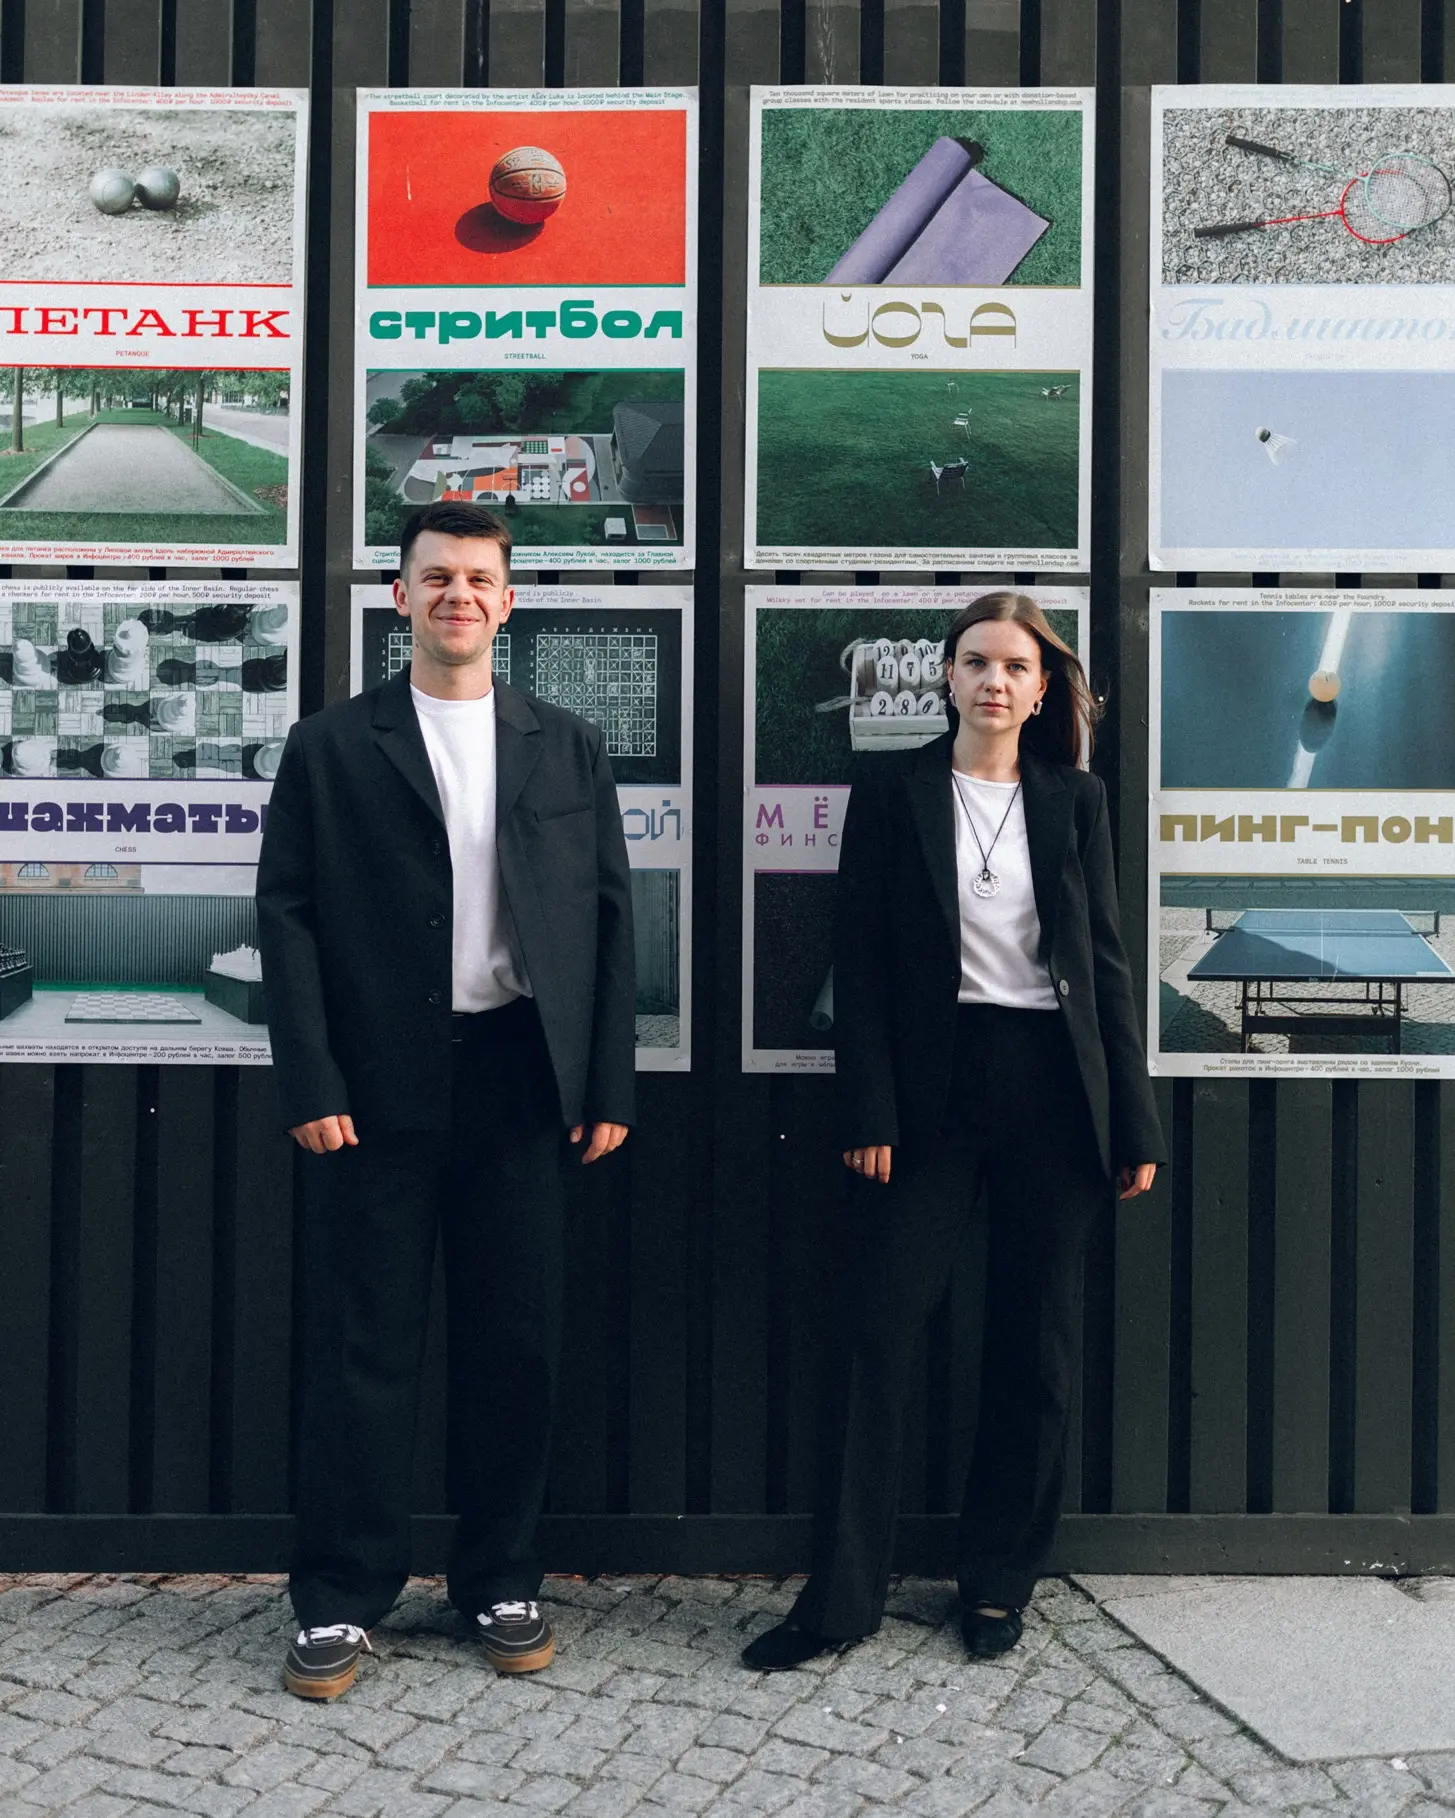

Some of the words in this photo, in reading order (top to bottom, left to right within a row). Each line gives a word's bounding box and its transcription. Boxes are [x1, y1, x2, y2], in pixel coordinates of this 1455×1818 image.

[577, 91, 604, 99] located
[607, 91, 630, 99] behind
[632, 91, 643, 99] the
[910, 90, 949, 99] practicing
[430, 98, 441, 106] for
[444, 98, 459, 106] rent
[472, 98, 484, 106] the
[638, 98, 665, 107] deposit
[762, 97, 783, 105] group
[814, 96, 829, 104] with
[832, 96, 843, 104] the
[369, 299, 683, 345] стритбол
[1161, 297, 1455, 342] Бадминто
[563, 556, 586, 565] рублей
[634, 556, 651, 564] 1000
[653, 556, 677, 565] рублей
[1, 583, 20, 591] chess
[33, 584, 63, 592] publicly
[168, 584, 179, 592] the
[229, 585, 257, 593] Regular
[83, 590, 94, 598] the
[212, 591, 242, 600] security
[244, 591, 272, 600] deposit
[542, 590, 574, 598] publicly
[850, 590, 874, 598] played
[1232, 598, 1248, 606] rent
[1398, 600, 1428, 609] security
[880, 663, 893, 679] 11
[906, 661, 914, 677] 7
[928, 661, 937, 677] 5
[878, 699, 887, 715] 2
[900, 699, 910, 716] 8
[621, 799, 681, 841] ой
[755, 833, 839, 847] ФИНС
[1297, 857, 1318, 865] TABLE
[1322, 857, 1349, 865] TENNIS
[189, 1044, 212, 1053] берегу
[168, 1051, 191, 1059] рублей
[238, 1051, 252, 1059] 500
[1325, 1065, 1350, 1074] рублей
[1396, 1065, 1414, 1073] 1000
[1415, 1065, 1440, 1074] рублей
